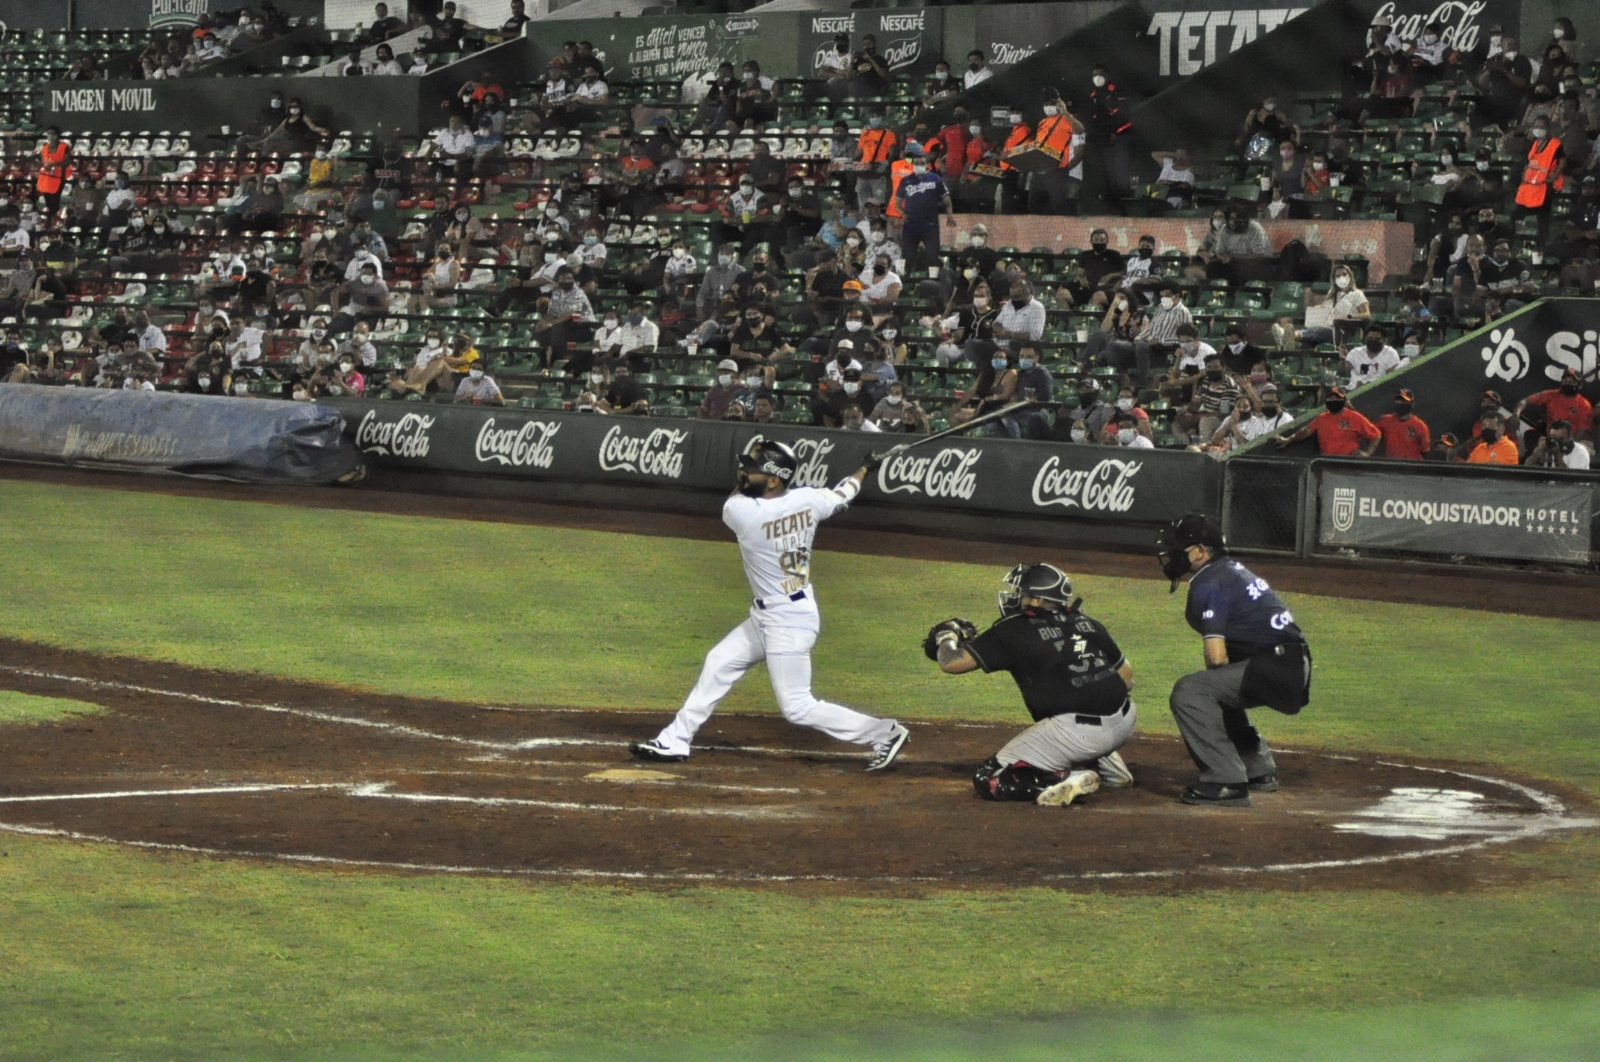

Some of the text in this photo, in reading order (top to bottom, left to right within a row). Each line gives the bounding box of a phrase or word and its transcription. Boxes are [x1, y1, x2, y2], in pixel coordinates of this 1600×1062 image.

[812, 12, 855, 33] NESCAFÉ
[880, 10, 925, 31] NESCAFÉ
[636, 36, 645, 48] ES
[677, 26, 705, 41] VENCER
[1147, 8, 1311, 76] TECAT
[663, 46, 675, 59] QUE
[885, 41, 918, 64] Dolca
[655, 63, 668, 76] POR
[51, 88, 156, 112] IMAGEN MOVIL
[475, 417, 562, 468] Coca-Cola
[599, 425, 689, 479] Coca-Cola
[1032, 456, 1143, 512] Coca-Cola
[1359, 497, 1579, 526] EL CONQUISTADOR HOTEL
[761, 509, 813, 540] TECATE
